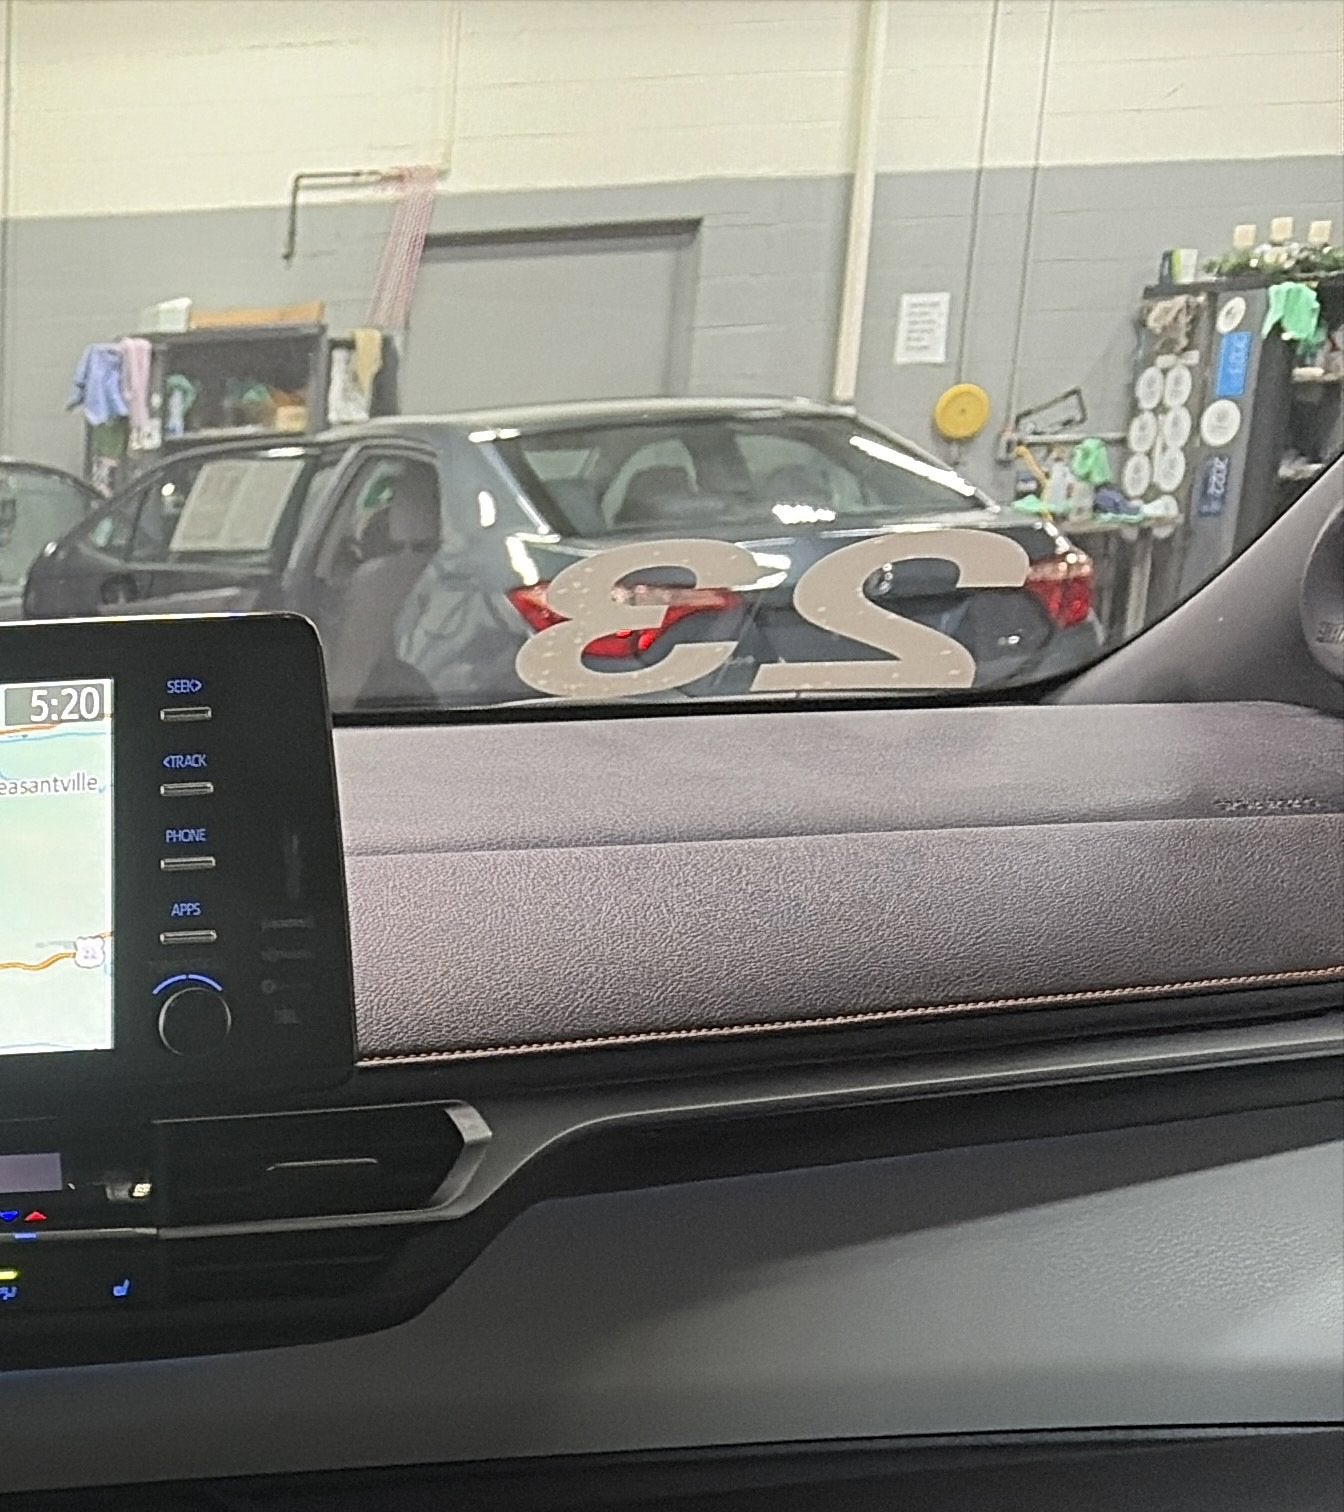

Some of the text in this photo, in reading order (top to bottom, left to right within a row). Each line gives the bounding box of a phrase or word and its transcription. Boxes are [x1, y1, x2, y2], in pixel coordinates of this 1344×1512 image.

[30, 687, 100, 722] 5:20
[165, 828, 207, 843] PHONE
[171, 902, 201, 917] APPS
